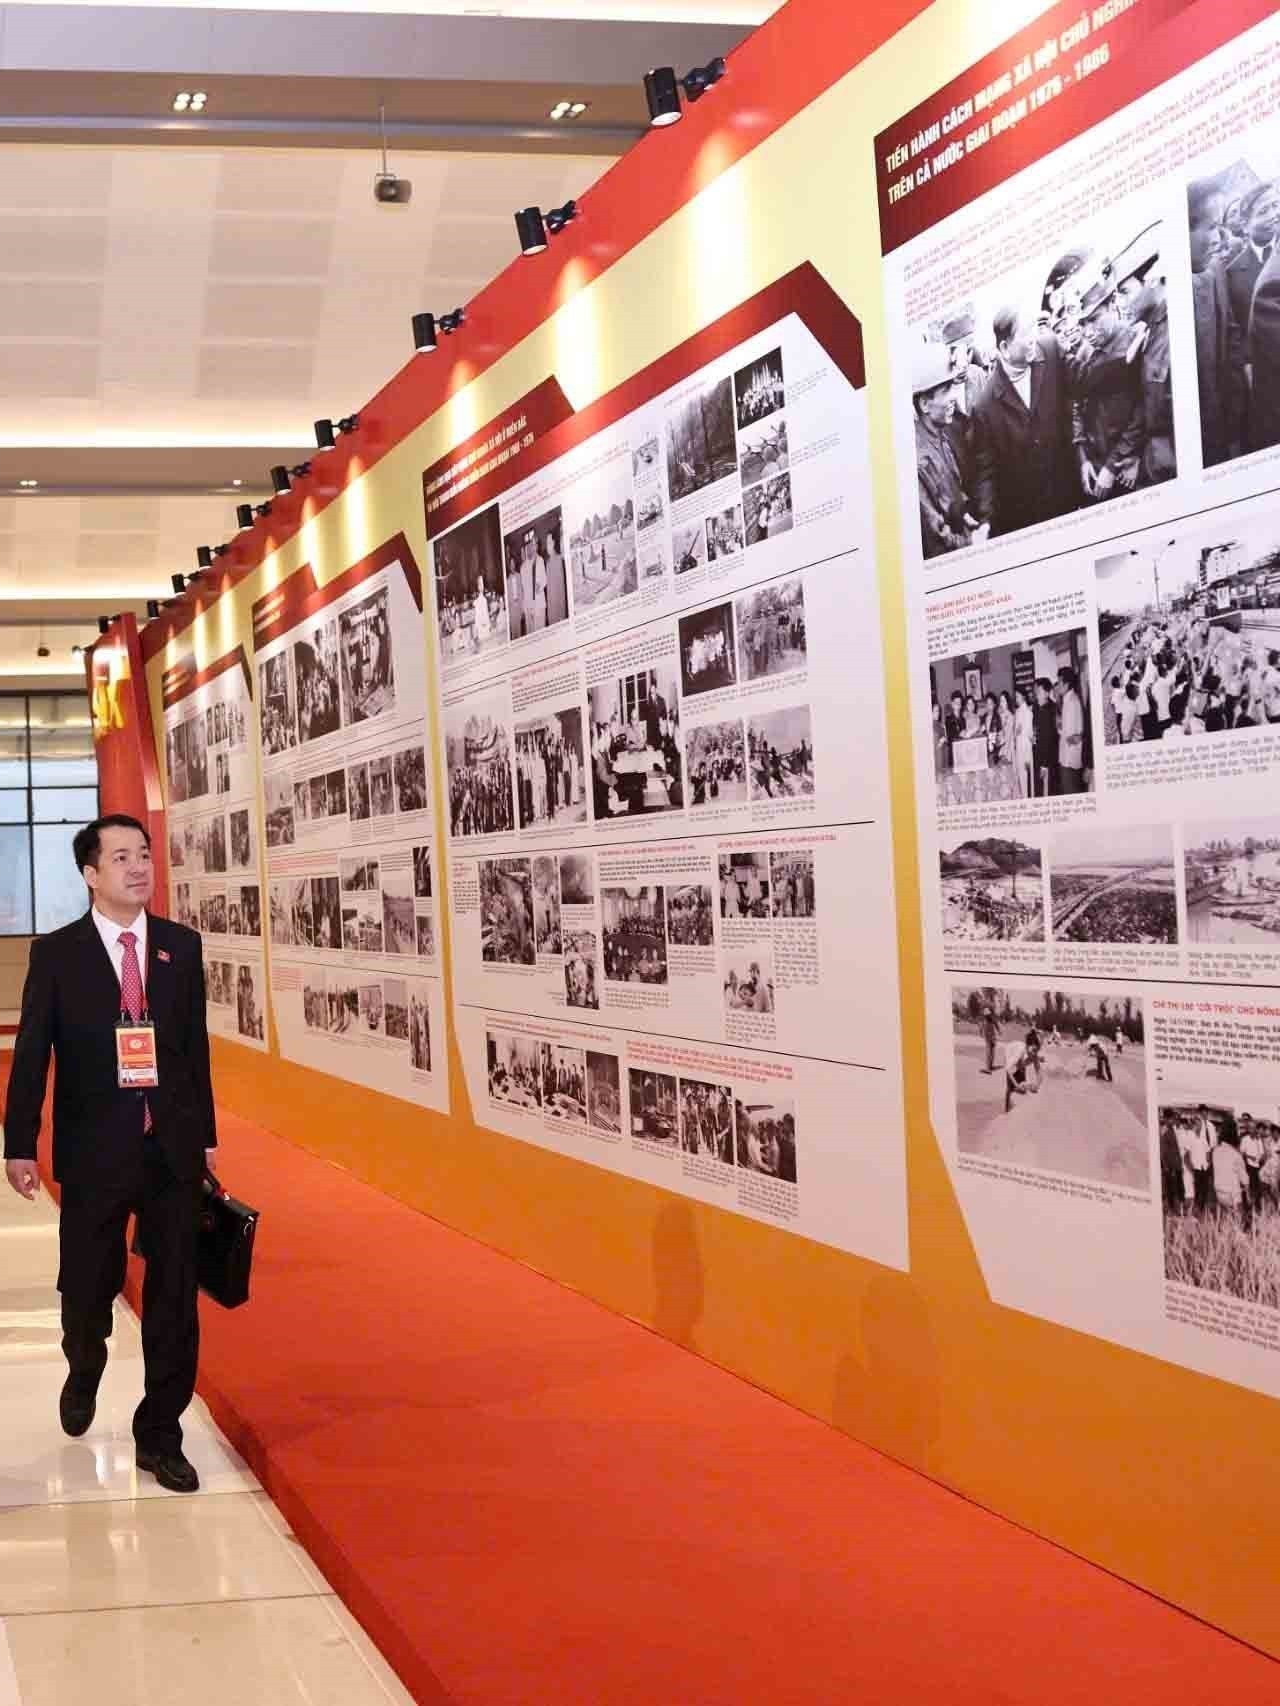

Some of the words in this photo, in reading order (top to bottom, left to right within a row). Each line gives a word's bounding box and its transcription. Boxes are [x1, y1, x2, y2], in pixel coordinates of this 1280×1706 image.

[885, 143, 909, 173] TIẾN
[910, 120, 941, 158] HÀNH
[942, 98, 973, 135] CÁCH
[974, 71, 1013, 112] MẠNG
[1059, 9, 1089, 52] CHỦ
[887, 172, 915, 205] TRÊN
[915, 157, 932, 186] CẢ
[932, 139, 965, 176] NƯỚC
[965, 121, 991, 153] GIAI
